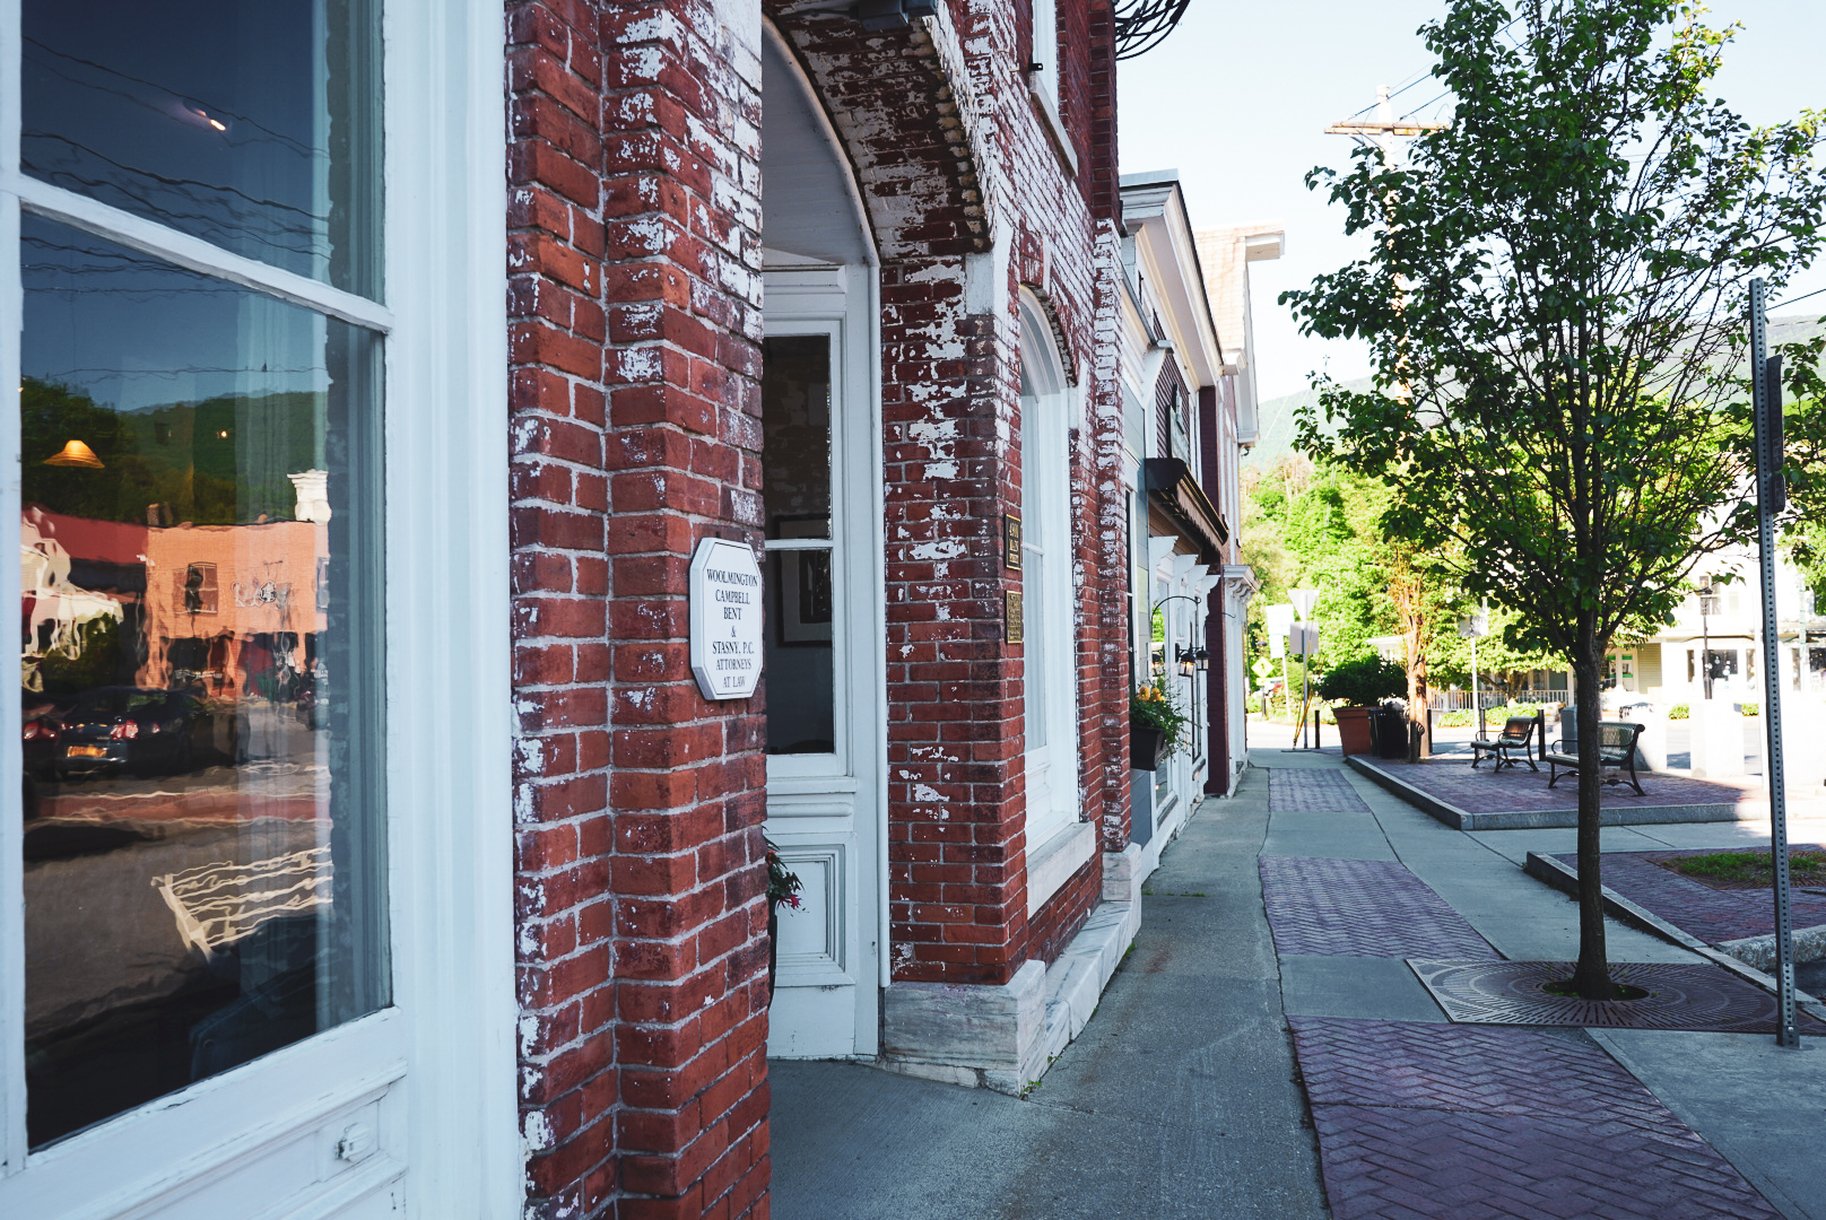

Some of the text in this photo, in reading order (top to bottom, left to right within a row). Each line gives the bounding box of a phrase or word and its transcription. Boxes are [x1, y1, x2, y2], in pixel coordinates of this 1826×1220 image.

[706, 568, 758, 587] WOOLMINGTON
[715, 589, 750, 605] CAMPBELL
[723, 607, 742, 620] BENT
[730, 625, 737, 638] &
[716, 658, 752, 671] ATTORNEYS
[723, 676, 746, 688] AT LAW
